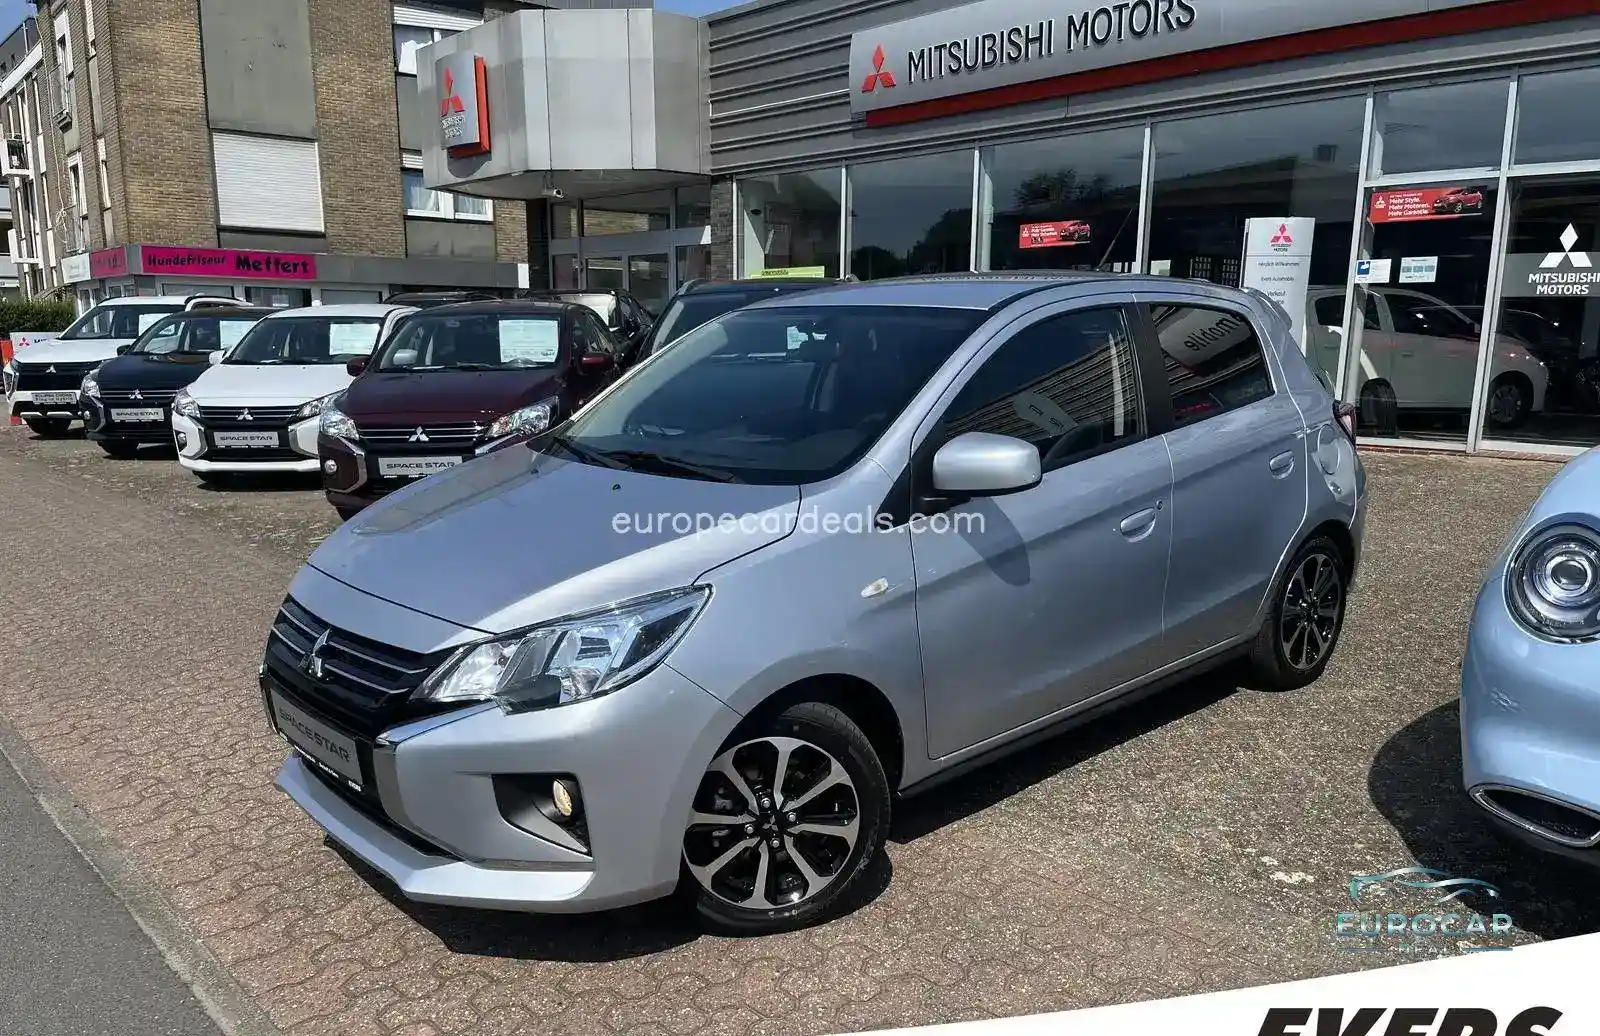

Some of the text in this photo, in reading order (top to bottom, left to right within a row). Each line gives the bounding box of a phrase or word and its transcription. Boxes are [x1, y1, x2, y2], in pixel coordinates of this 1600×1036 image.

[908, 0, 1197, 84] MITSUBISHI MOTORS
[147, 252, 308, 273] Hundefriseur Meffert
[1528, 272, 1600, 284] MITSUBISHI
[1536, 284, 1590, 295] MOTORS
[280, 709, 315, 741] SPACE
[313, 732, 350, 762] STAR
